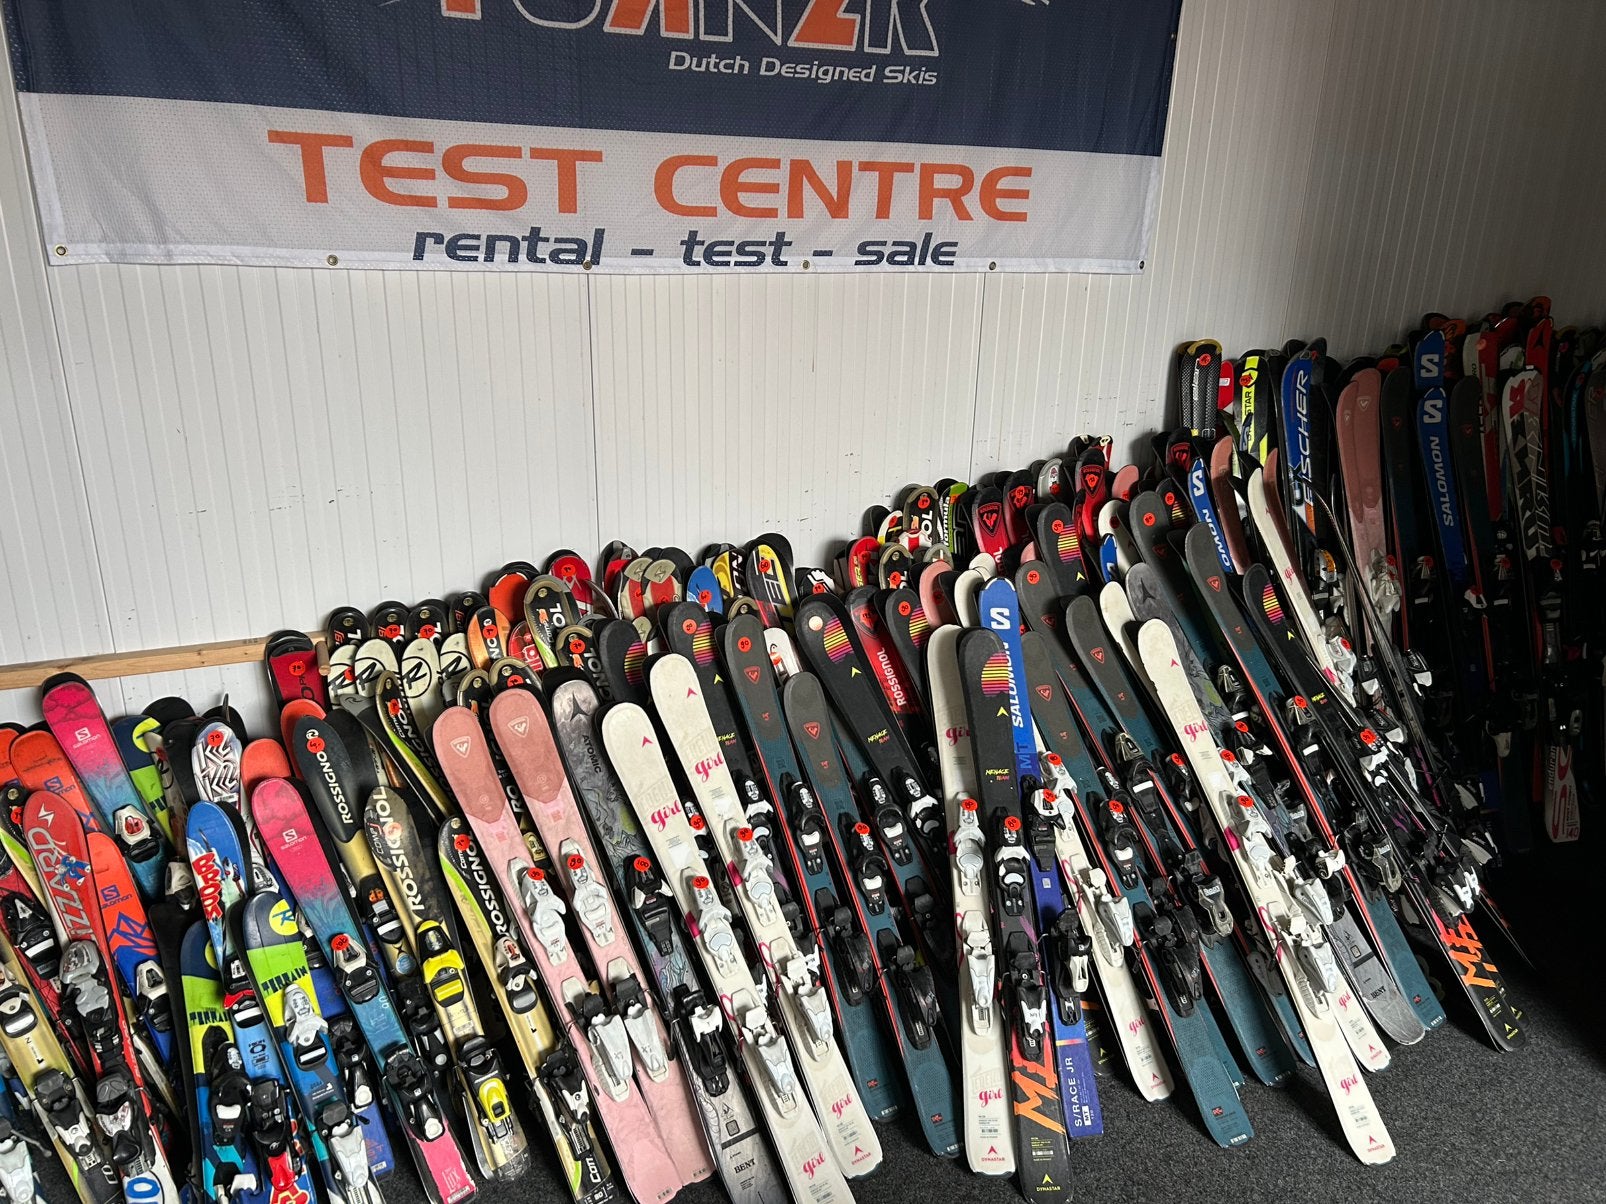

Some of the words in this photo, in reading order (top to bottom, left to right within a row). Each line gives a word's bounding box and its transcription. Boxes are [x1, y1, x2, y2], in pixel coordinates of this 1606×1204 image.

[668, 51, 750, 75] Dutch
[759, 57, 876, 84] Designed
[883, 66, 938, 85] Skis
[267, 129, 603, 214] TEST
[653, 154, 1033, 222] CENTRE
[412, 226, 606, 265] rental
[680, 230, 793, 267] test
[855, 232, 959, 267] sale
[1429, 436, 1454, 527] SALOMON
[877, 647, 907, 706] ROSSIGNOL
[1183, 719, 1208, 743] girl
[582, 734, 602, 774] ATOMIC
[695, 751, 725, 783] girl
[316, 751, 354, 824] ROSSIGNO
[651, 800, 682, 832] girl
[637, 860, 649, 868] 100
[1338, 991, 1352, 1011] girl
[1371, 986, 1386, 999] BENT
[189, 1010, 229, 1026] TERRAI
[1128, 1015, 1146, 1037] girl
[1065, 1057, 1075, 1073] JR
[978, 1087, 1003, 1109] girl
[1340, 1074, 1359, 1096] girl
[831, 1093, 853, 1119] girl
[1068, 1077, 1083, 1127] S/RACE
[734, 1158, 756, 1174] BENT
[803, 1152, 826, 1180] girl
